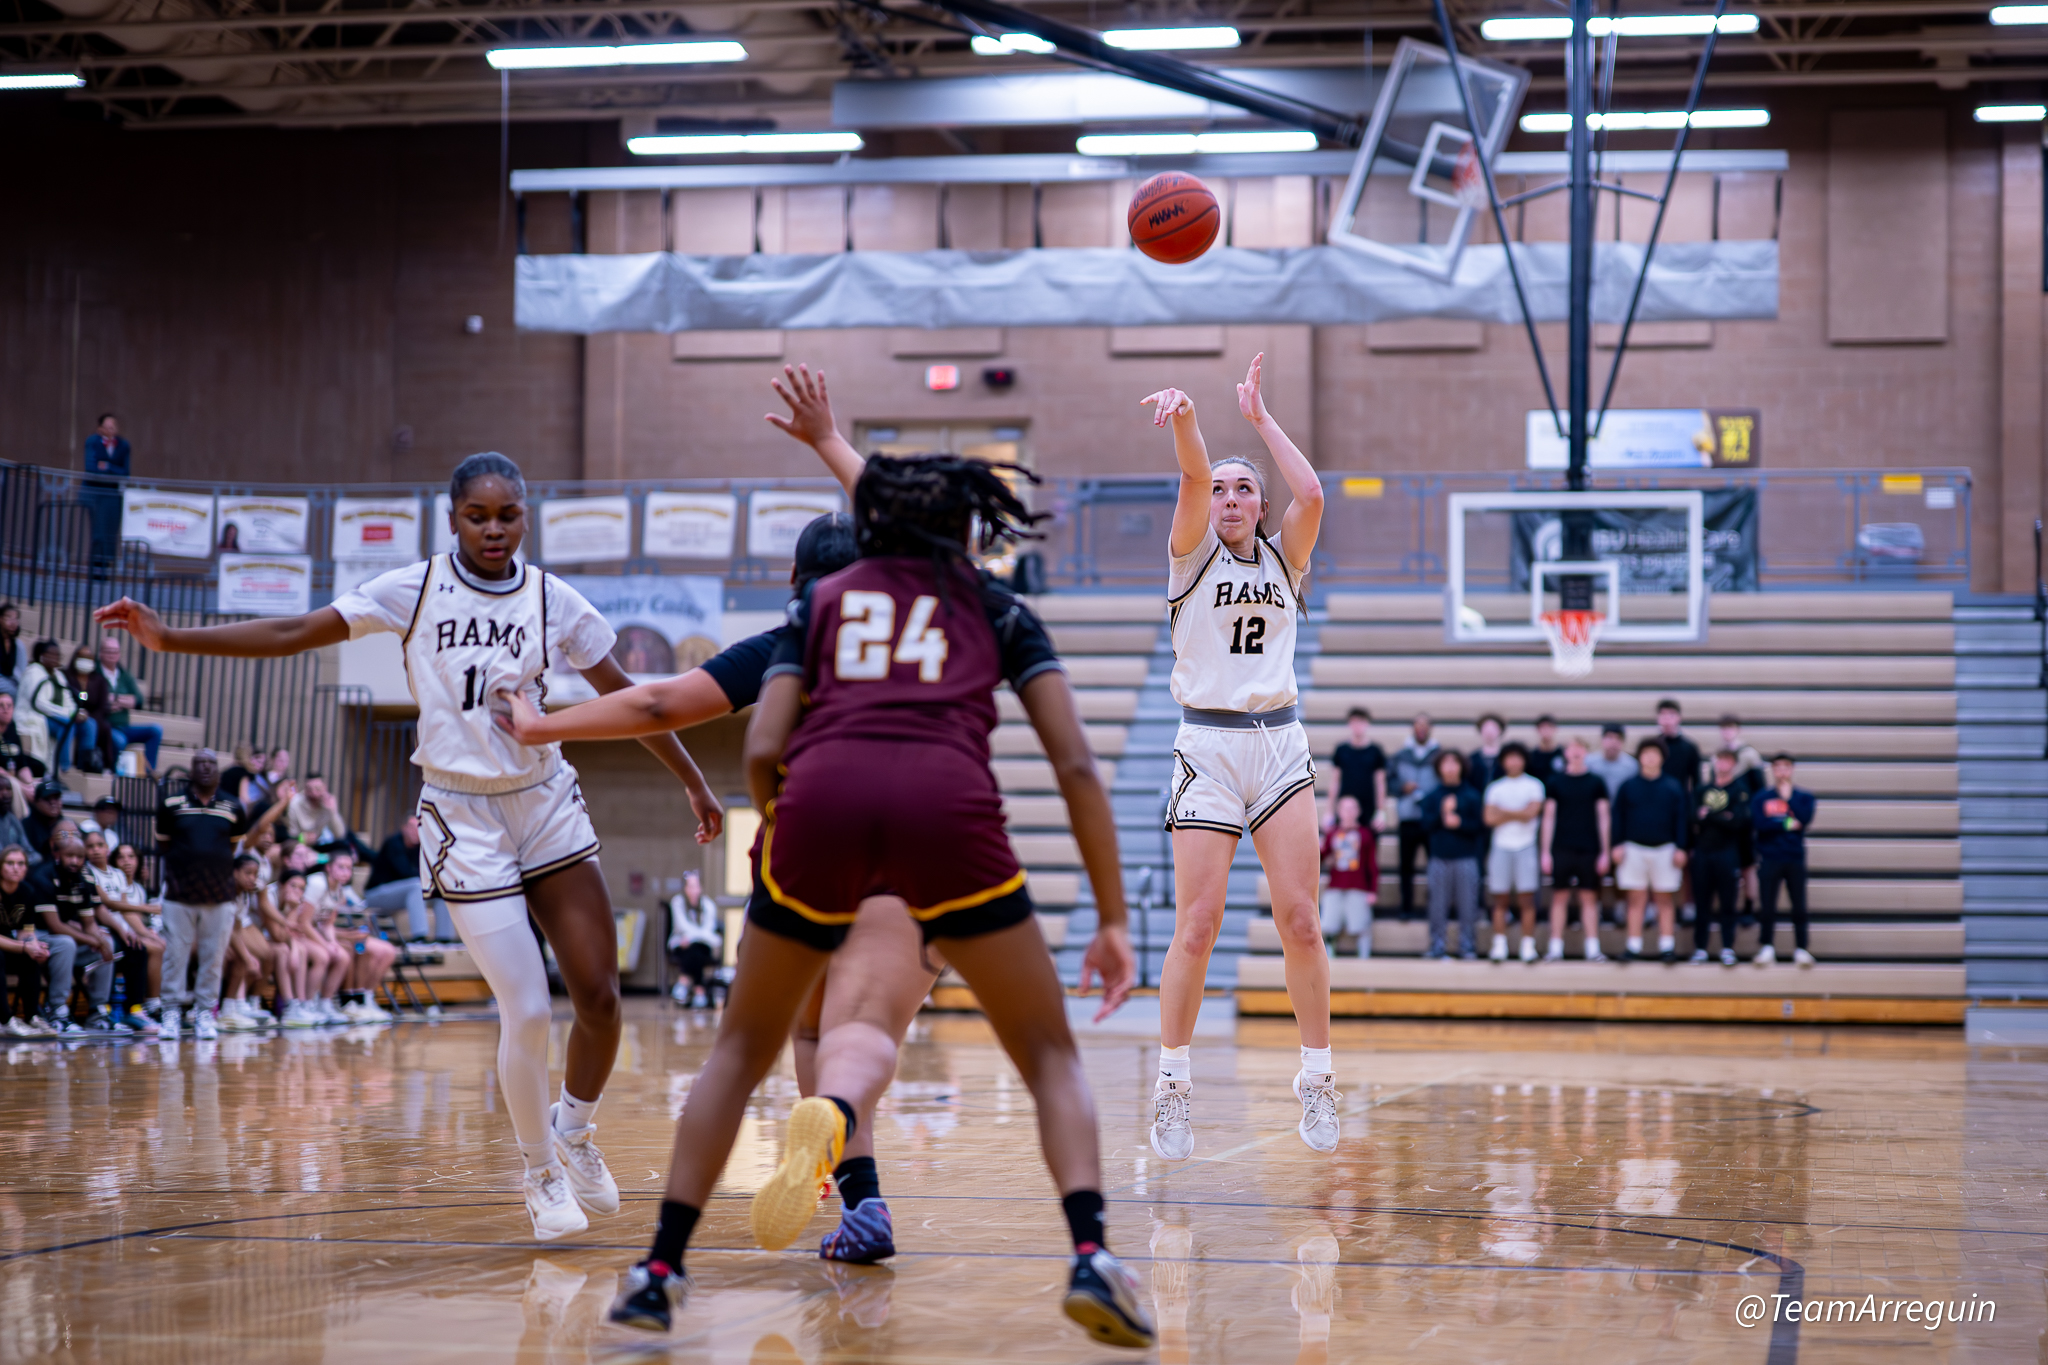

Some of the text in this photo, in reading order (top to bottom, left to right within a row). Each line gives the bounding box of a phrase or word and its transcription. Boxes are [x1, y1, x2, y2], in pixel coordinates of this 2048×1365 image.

[1213, 581, 1285, 609] RAMS
[436, 617, 526, 659] RAMS
[834, 589, 949, 684] 24
[1229, 615, 1266, 655] 12
